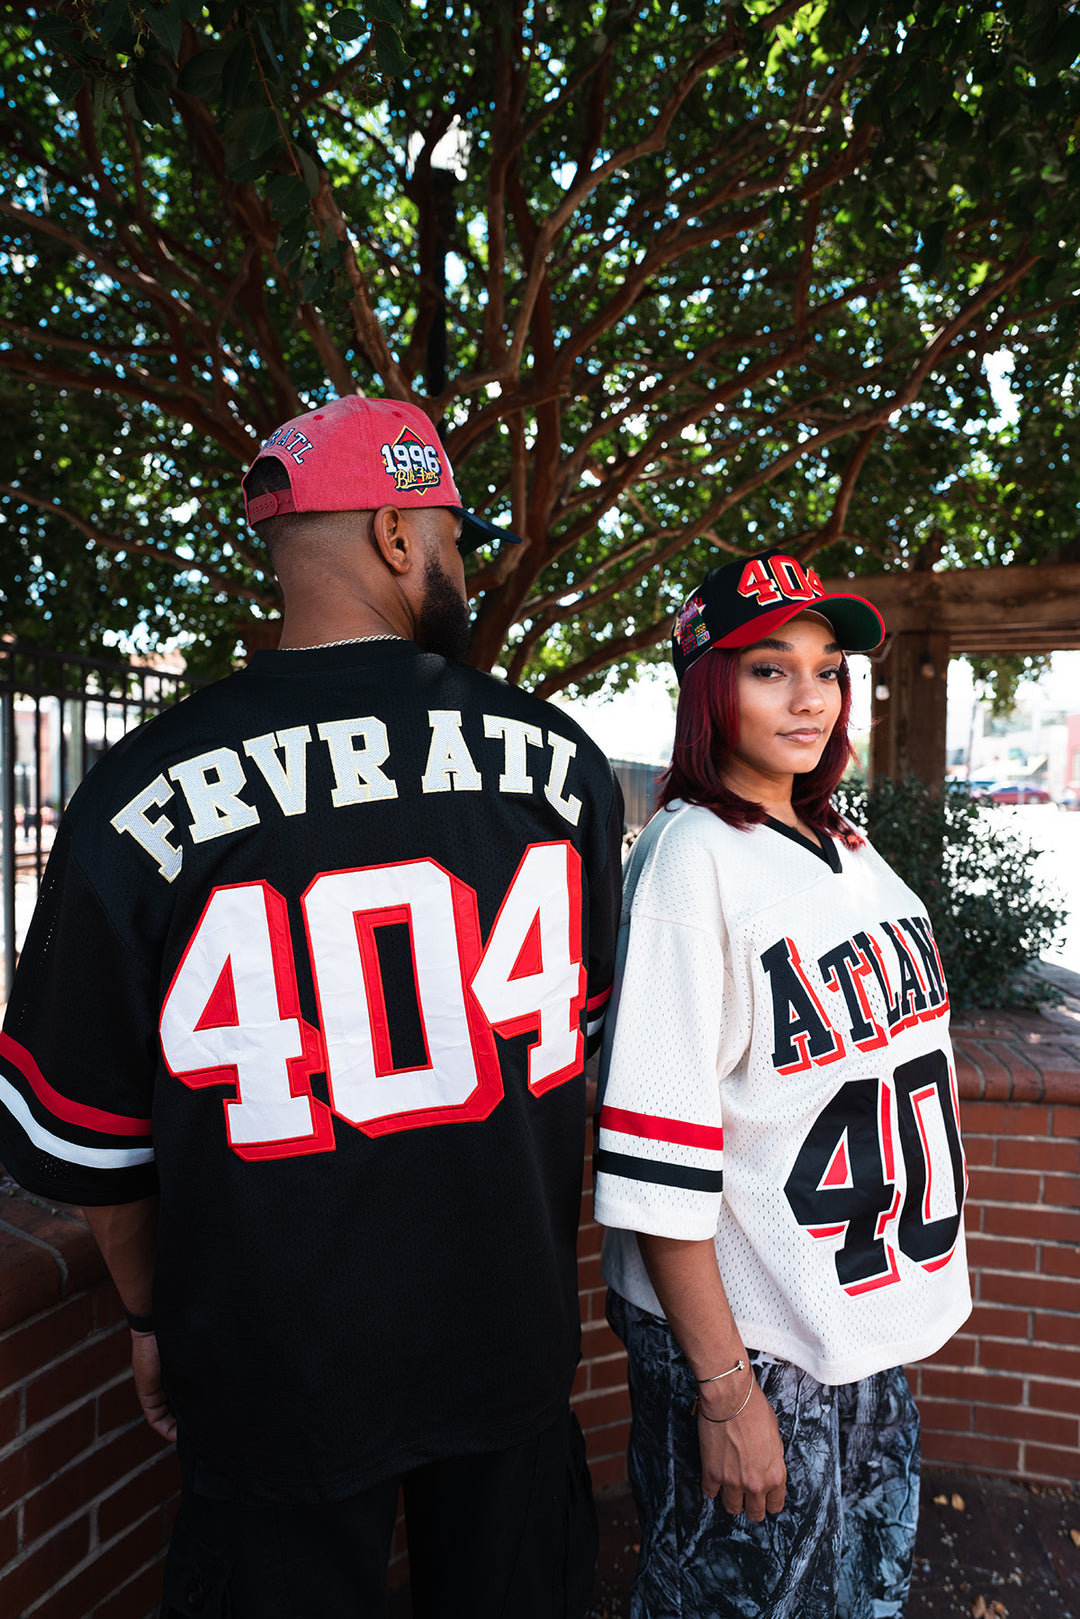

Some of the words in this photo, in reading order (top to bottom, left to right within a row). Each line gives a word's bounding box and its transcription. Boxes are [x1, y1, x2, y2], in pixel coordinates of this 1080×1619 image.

[381, 443, 441, 474] 1996
[109, 715, 399, 883] FRVR
[421, 709, 582, 827] ATL
[158, 839, 588, 1162] 404
